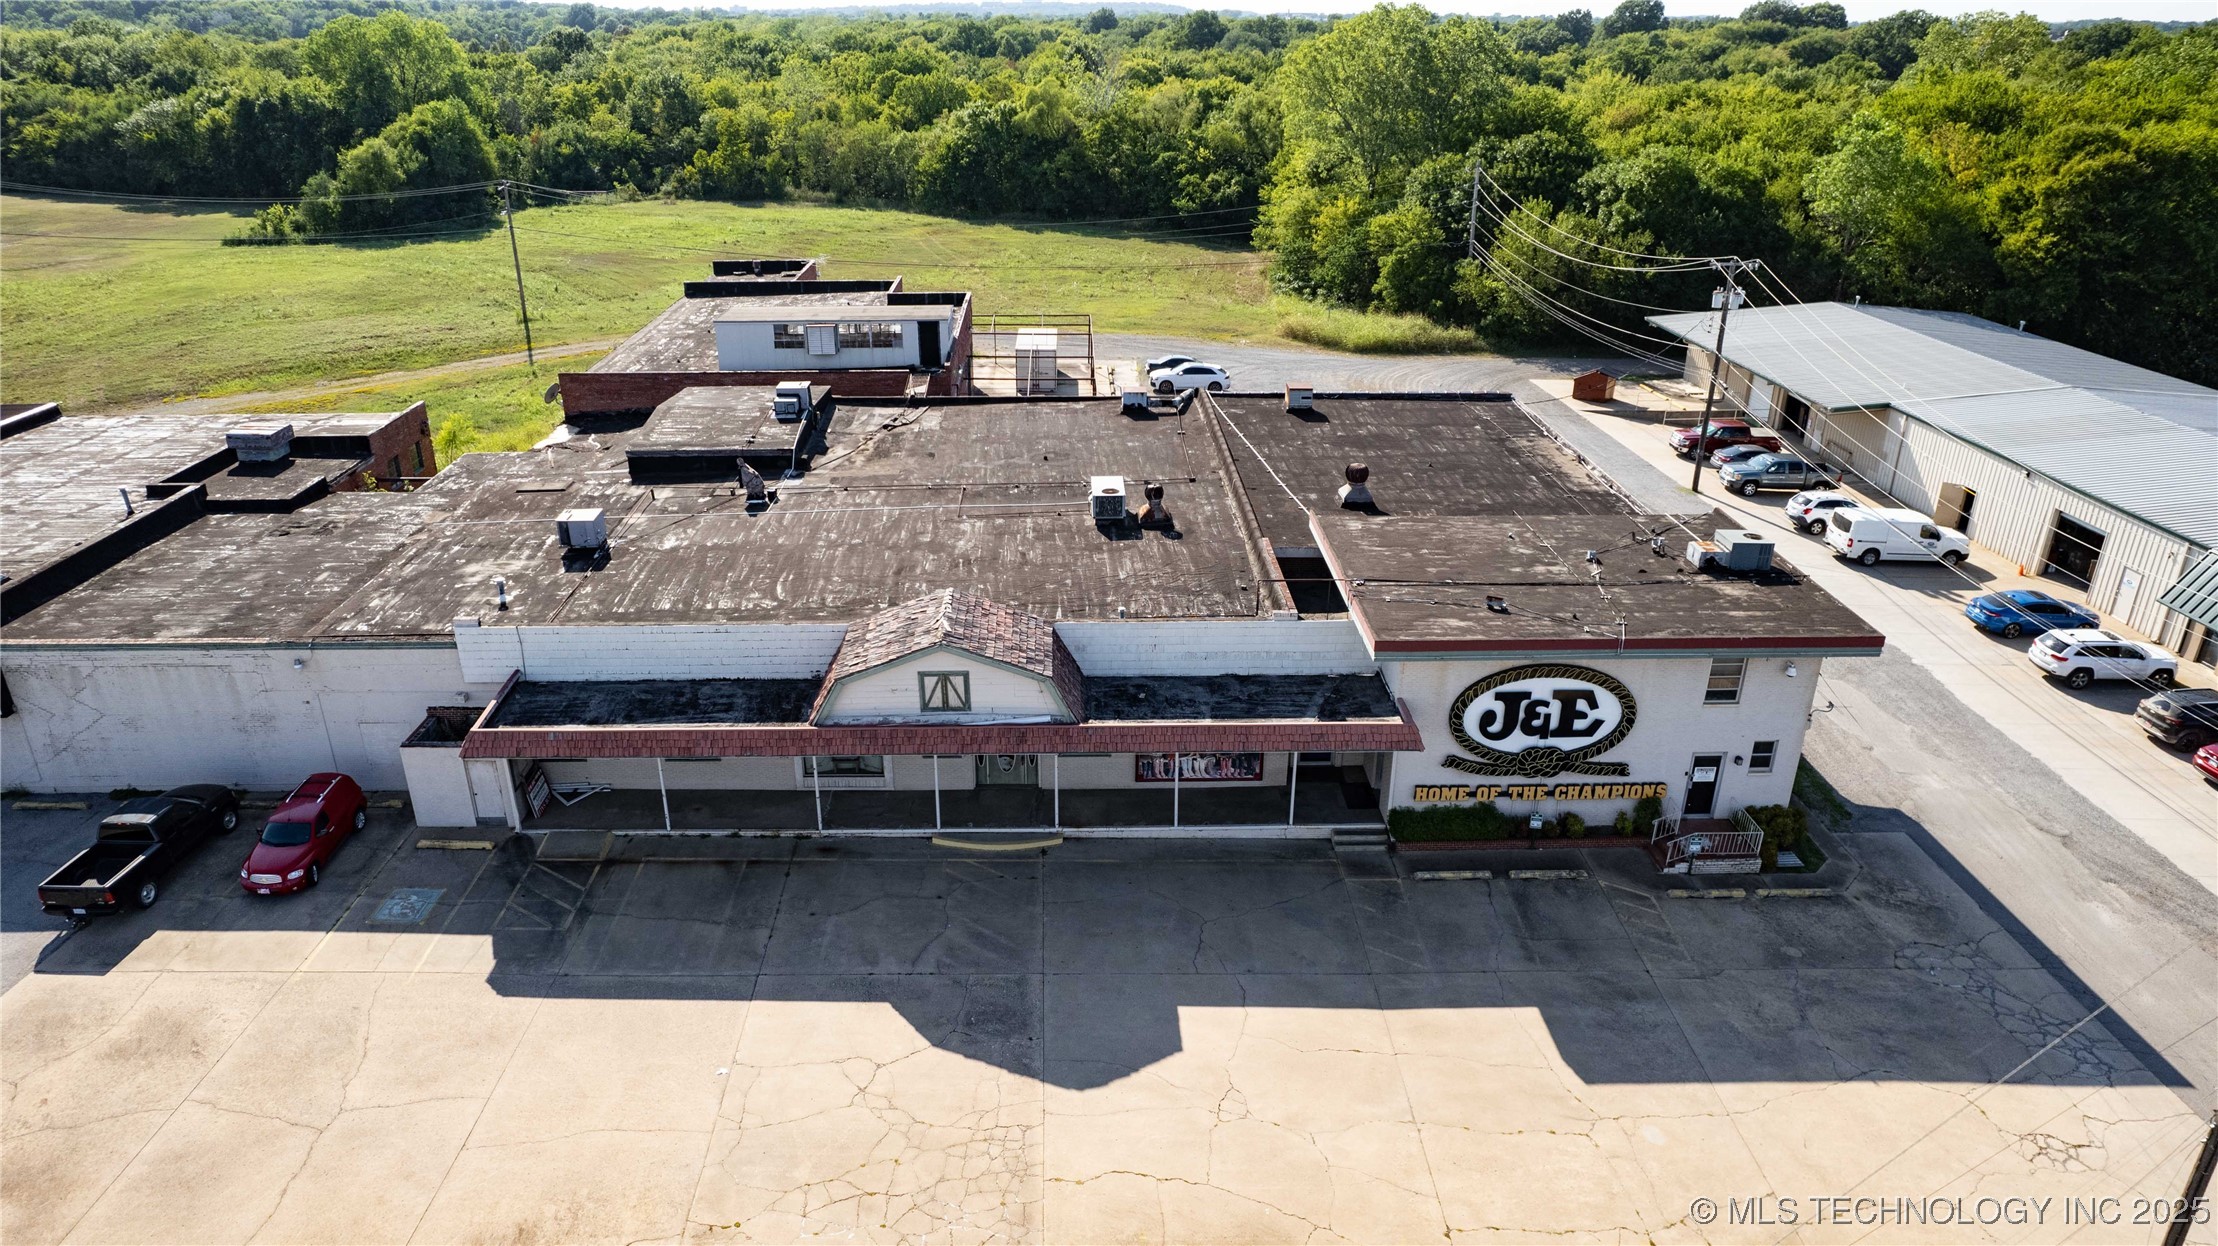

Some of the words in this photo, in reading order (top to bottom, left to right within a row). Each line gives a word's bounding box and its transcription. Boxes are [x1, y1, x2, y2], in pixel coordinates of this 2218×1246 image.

[1478, 689, 1606, 742] J&E
[1414, 786, 1471, 802] HOME
[1475, 786, 1502, 802] OF
[1508, 785, 1549, 801] THE
[1554, 783, 1668, 801] CHAMPIONS
